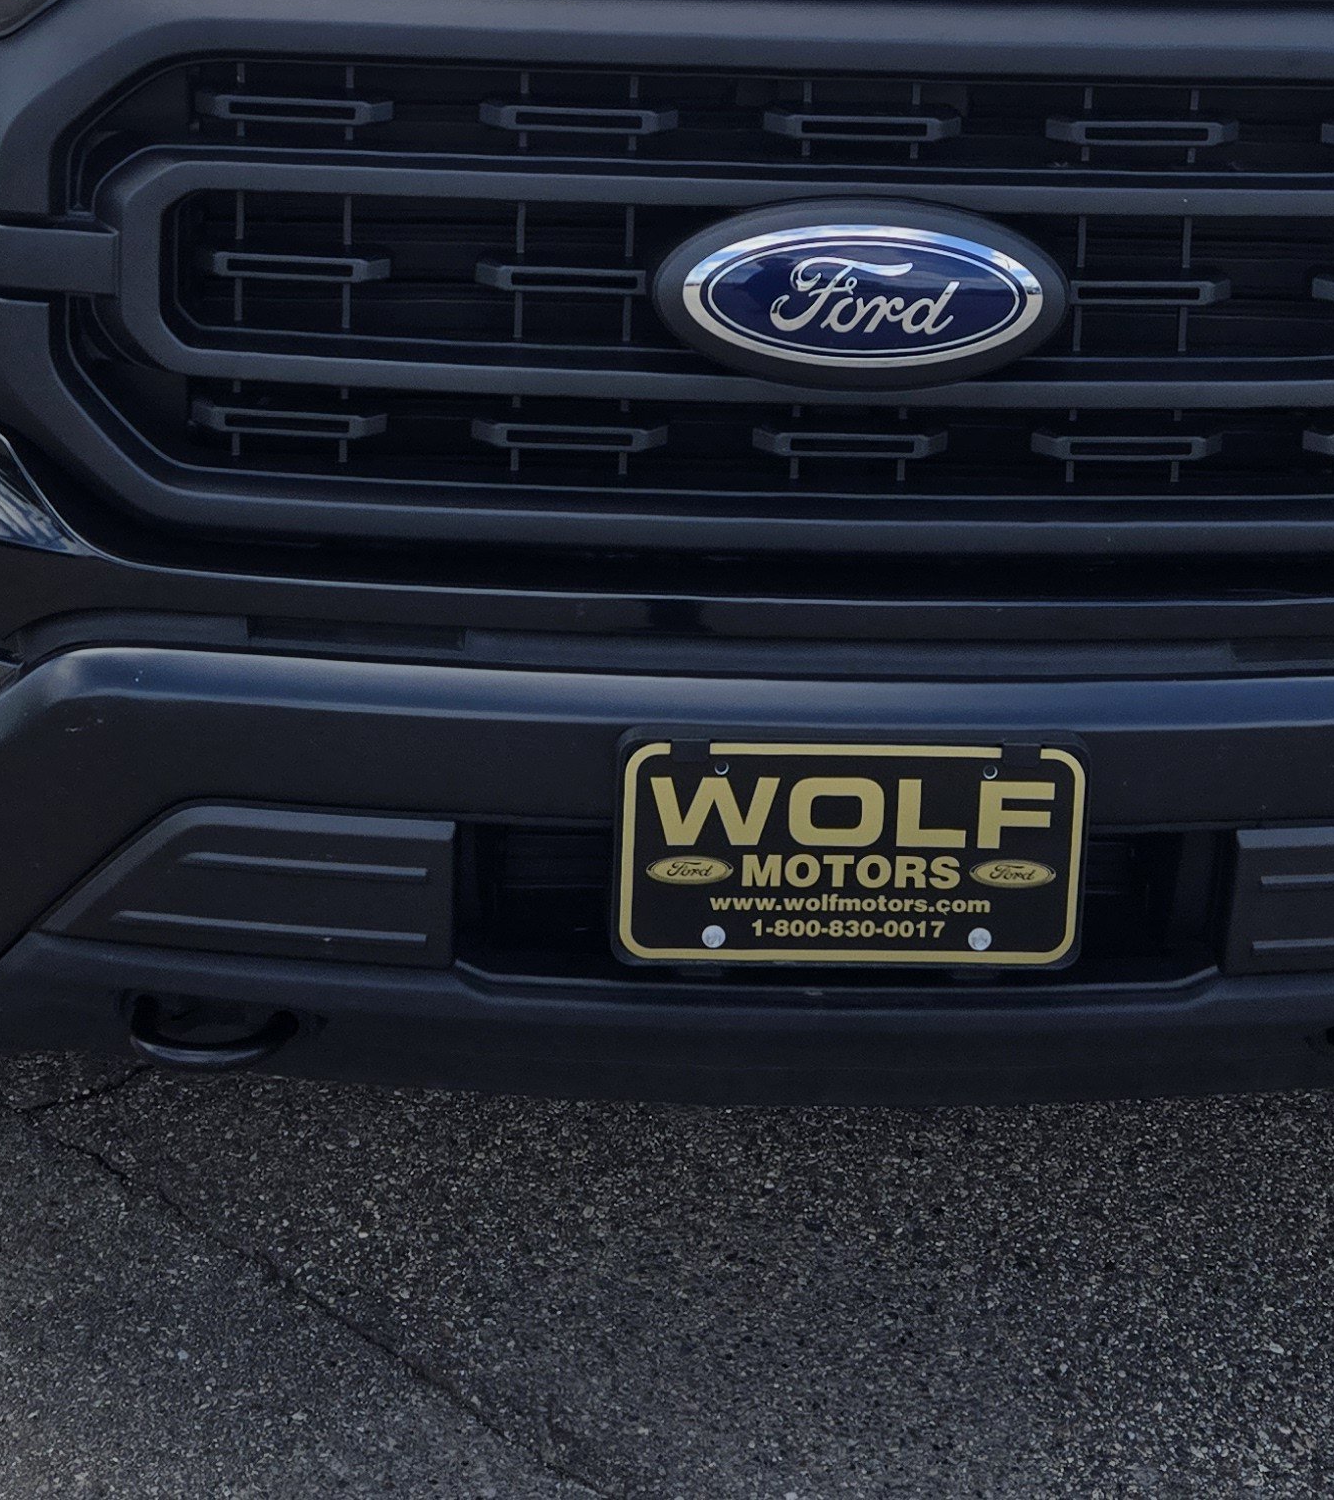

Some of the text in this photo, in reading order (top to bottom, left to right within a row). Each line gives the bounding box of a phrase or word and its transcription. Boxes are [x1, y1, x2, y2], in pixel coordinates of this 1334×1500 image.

[770, 256, 960, 335] Ford
[650, 776, 1056, 849] WOLF
[741, 853, 961, 890] MOTORS
[710, 893, 991, 915] www.wolfmotors.com
[751, 918, 946, 939] 1-800-830-0017
